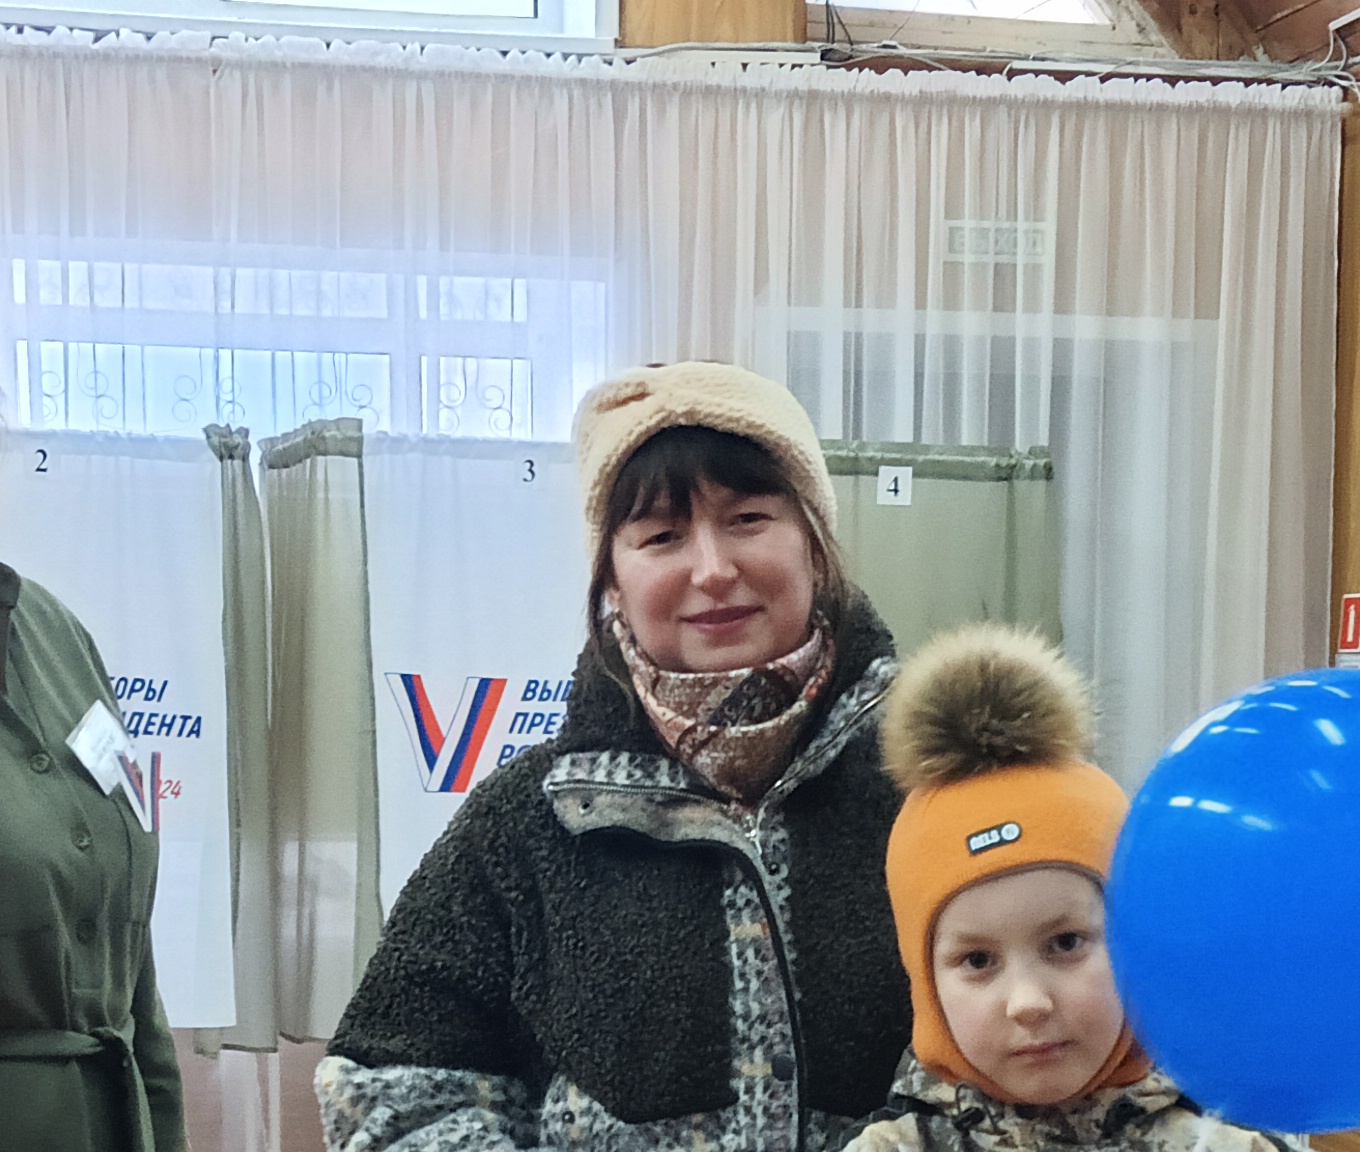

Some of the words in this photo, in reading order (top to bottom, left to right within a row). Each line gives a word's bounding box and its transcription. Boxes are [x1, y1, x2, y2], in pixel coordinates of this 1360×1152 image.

[34, 448, 48, 473] 2
[522, 459, 536, 483] 3
[886, 475, 900, 497] 4
[110, 676, 169, 702] ОРЫ
[121, 711, 203, 738] ДЕНТА
[508, 711, 568, 734] ПРЕ
[157, 779, 182, 799] 24
